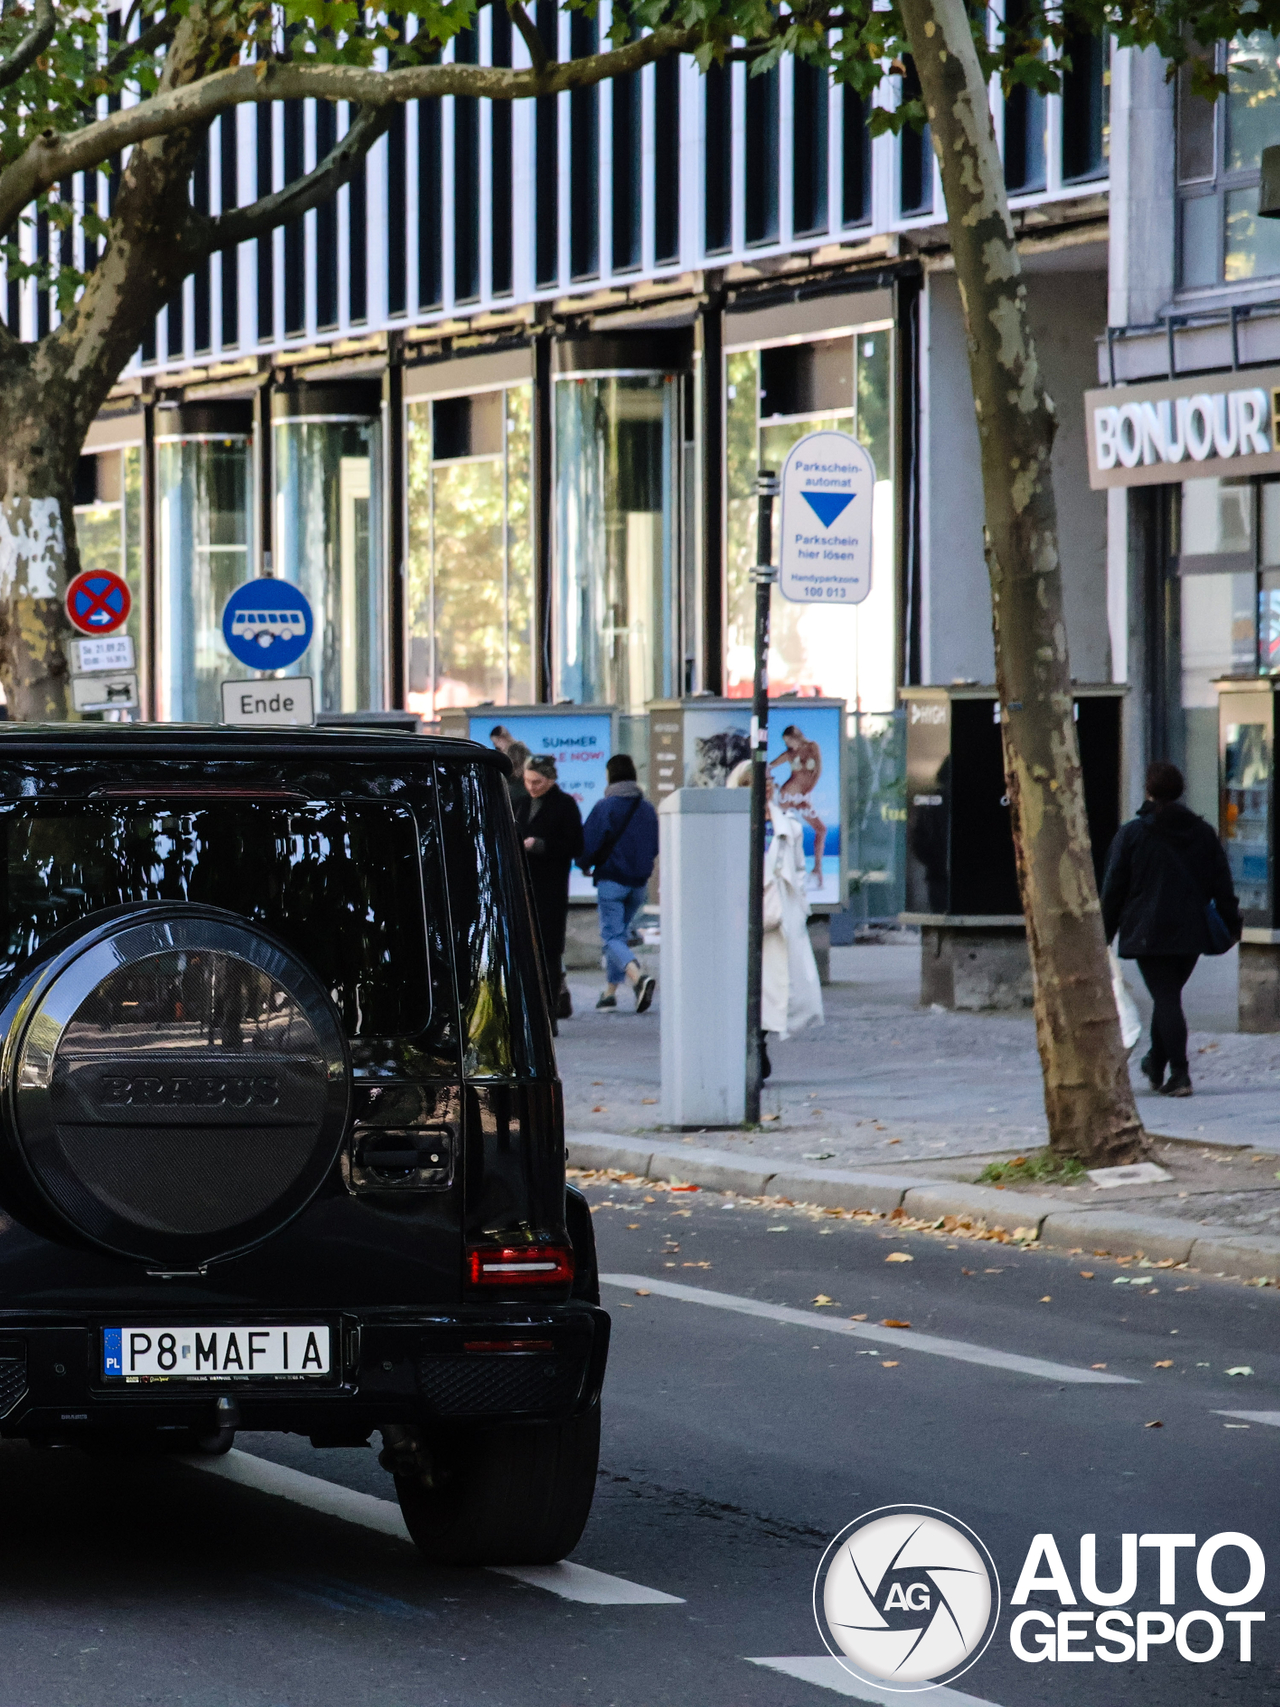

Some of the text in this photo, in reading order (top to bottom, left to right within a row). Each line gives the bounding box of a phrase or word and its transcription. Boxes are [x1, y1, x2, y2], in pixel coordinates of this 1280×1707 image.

[1094, 387, 1270, 470] BONJOUR
[795, 461, 862, 474] Parkschein-
[805, 477, 851, 488] automat
[795, 534, 859, 546] Parkschein
[798, 550, 854, 560] hier lösen
[791, 574, 859, 585] Handyparkzone
[804, 587, 846, 598] 100 013
[240, 694, 294, 714] Ende
[542, 736, 597, 748] SUMMER
[100, 1076, 280, 1107] BRABUS
[130, 1332, 322, 1371] P8 MAFIA
[106, 1358, 120, 1369] PL
